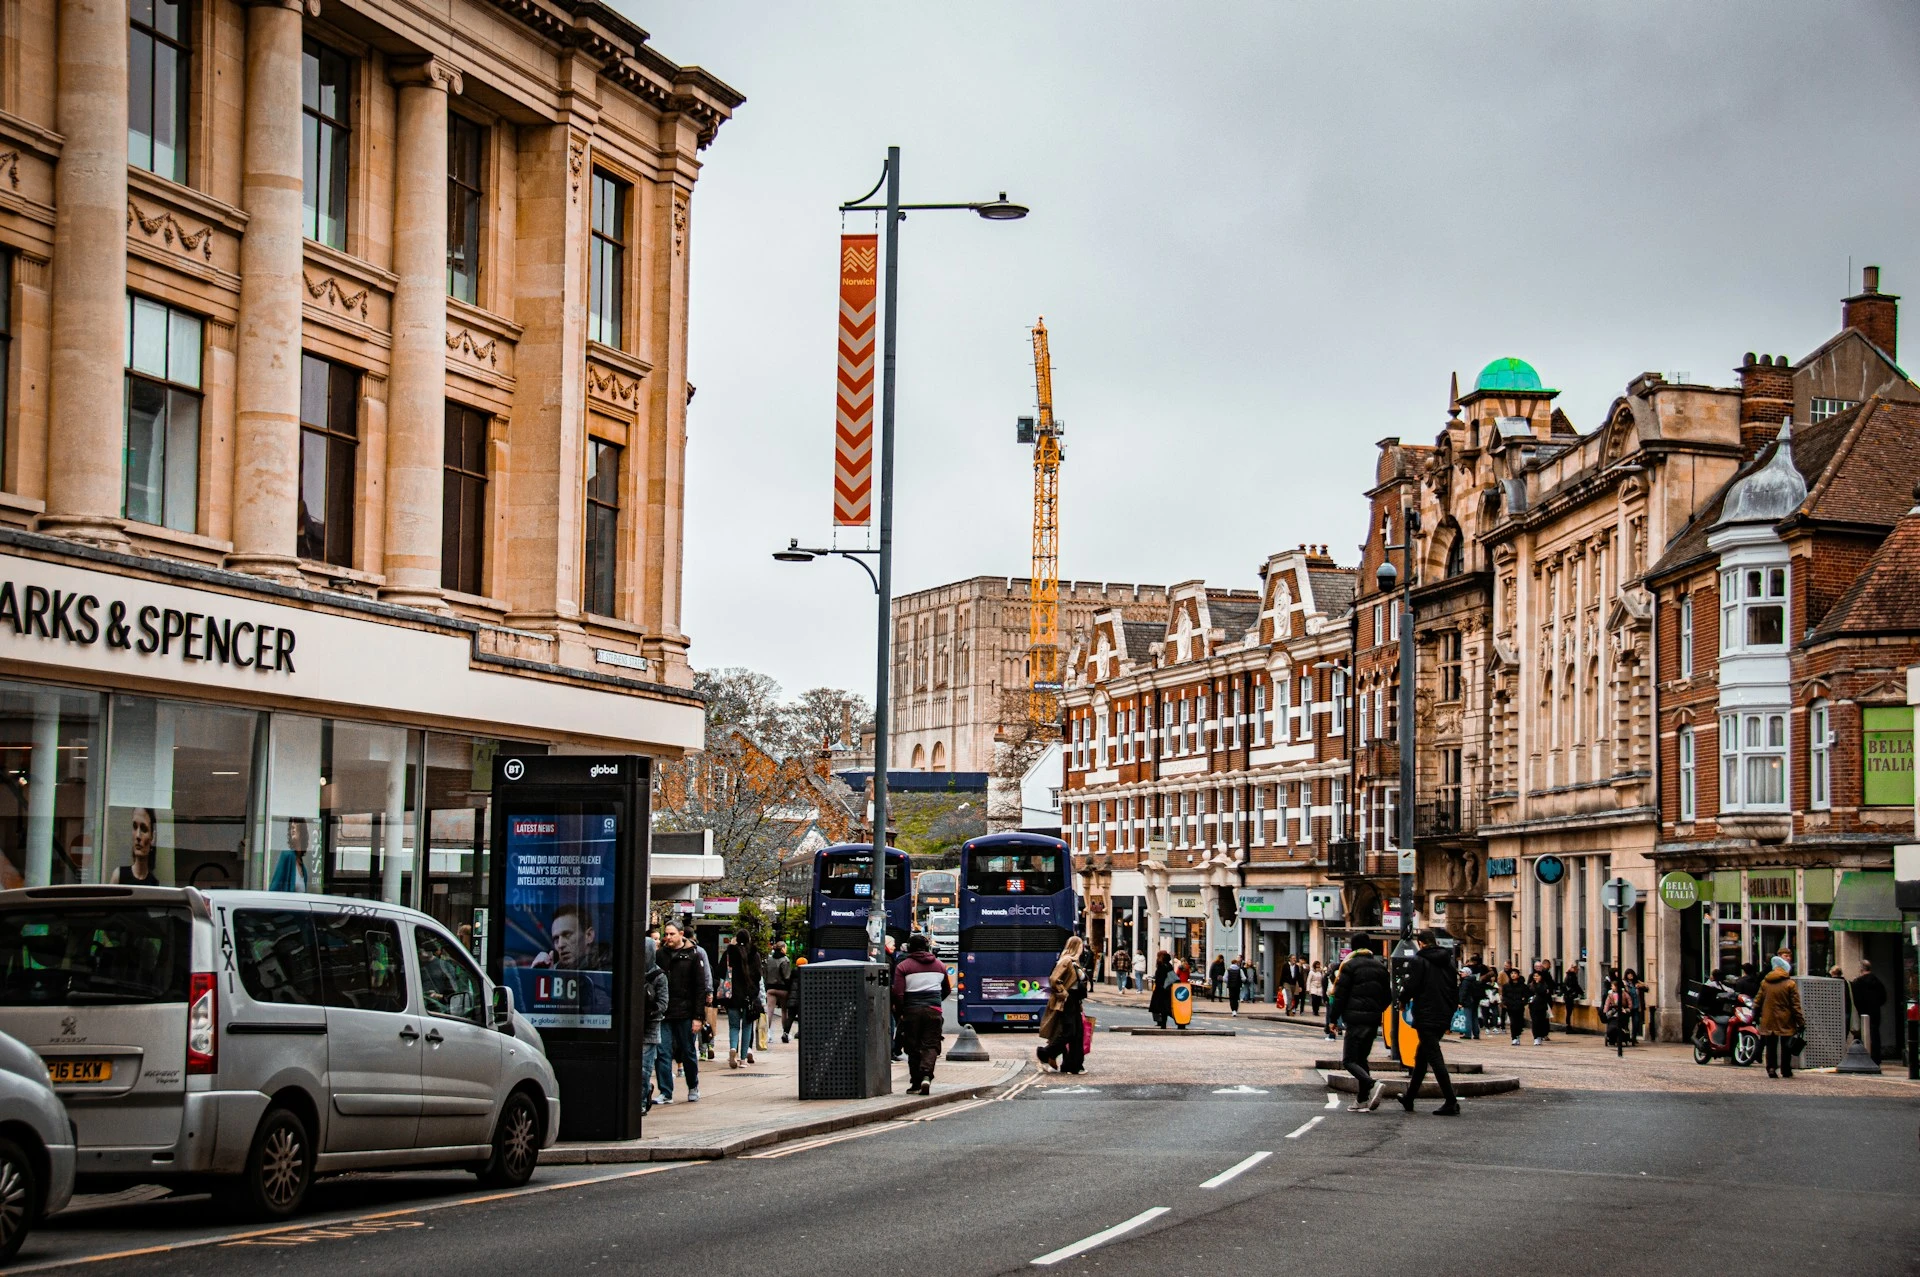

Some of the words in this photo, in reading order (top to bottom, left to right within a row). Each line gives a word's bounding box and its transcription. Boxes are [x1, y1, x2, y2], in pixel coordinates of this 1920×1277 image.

[107, 600, 131, 649] &
[137, 605, 296, 673] SPENCER
[1868, 740, 1914, 753] BELLA
[508, 765, 520, 774] BT
[590, 764, 618, 777] global
[1867, 758, 1914, 771] ITALIA
[516, 824, 538, 833] LATEST
[538, 824, 555, 833] NEWS
[537, 856, 548, 864] DID
[548, 856, 559, 864] NOT
[560, 856, 580, 864] ORDER
[581, 856, 601, 864] ALEXEI
[517, 866, 550, 875] NAVALNY'S
[573, 866, 581, 874] US
[517, 877, 557, 886] INTELLIGENCE
[557, 877, 585, 886] AGENCIES
[586, 877, 605, 886] CLAIM
[1665, 882, 1694, 890] BELLA
[1665, 891, 1695, 899] ITALIA
[337, 904, 379, 917] TAXI
[1008, 904, 1050, 915] electric
[217, 906, 236, 994] TAXI
[540, 977, 577, 999] LBC
[73, 1063, 102, 1078] EKW
